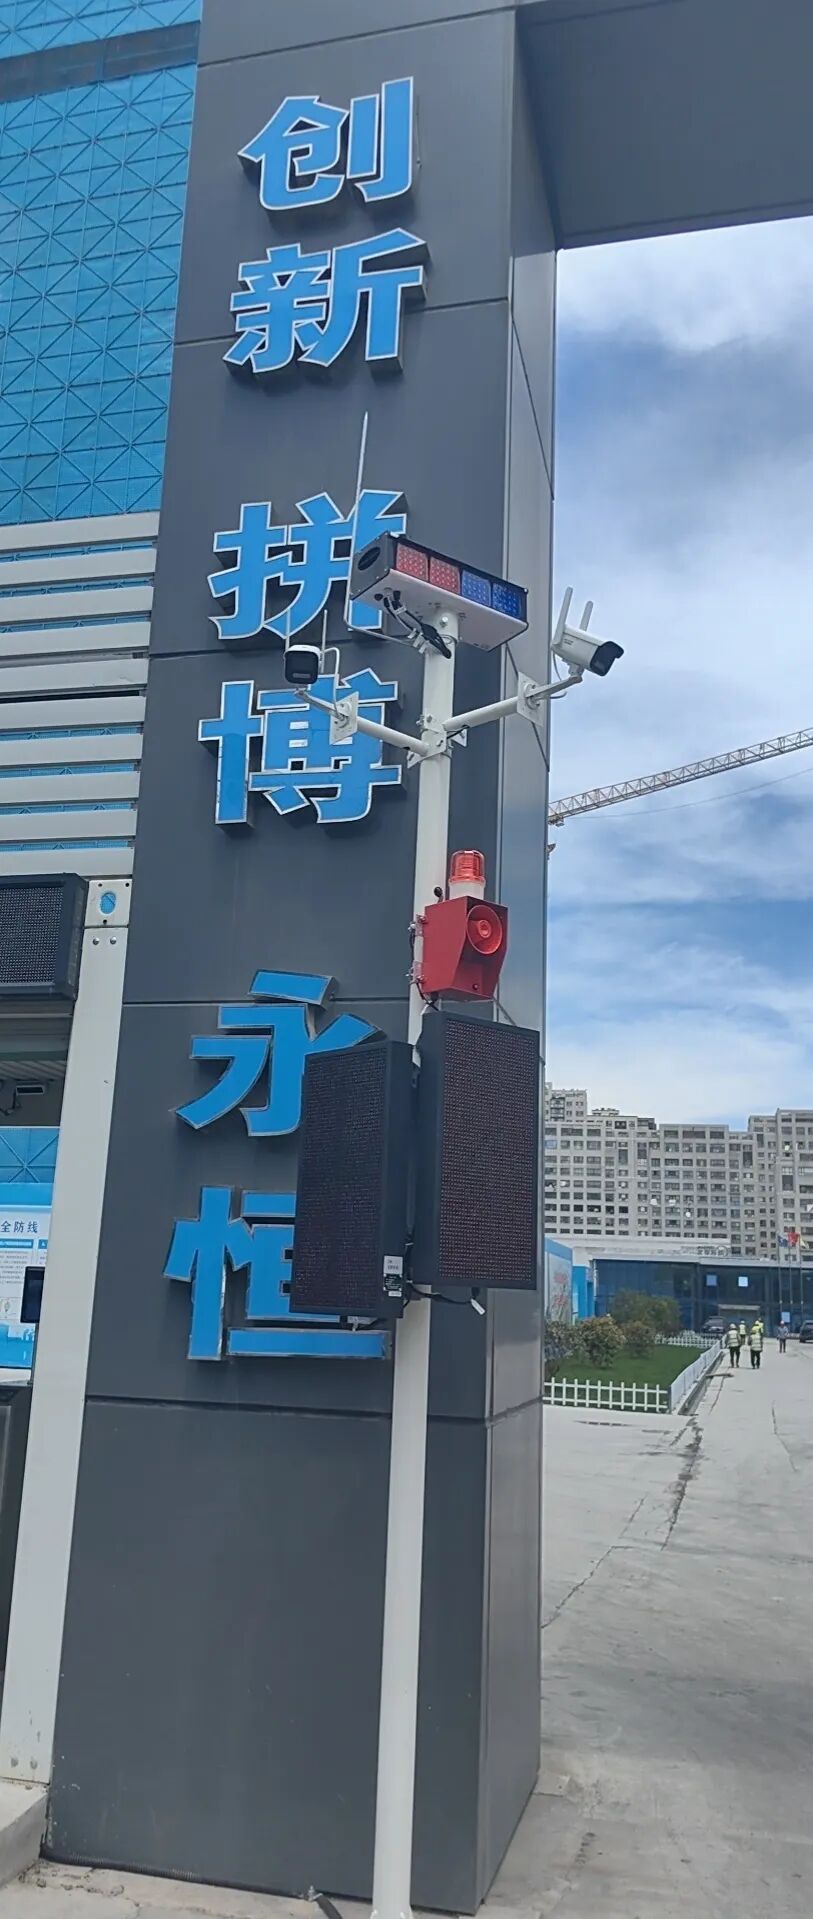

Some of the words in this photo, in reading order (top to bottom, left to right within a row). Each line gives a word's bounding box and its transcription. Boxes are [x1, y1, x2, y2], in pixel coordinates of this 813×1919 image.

[222, 76, 425, 374] 创新
[1, 1220, 39, 1234] 全防线
